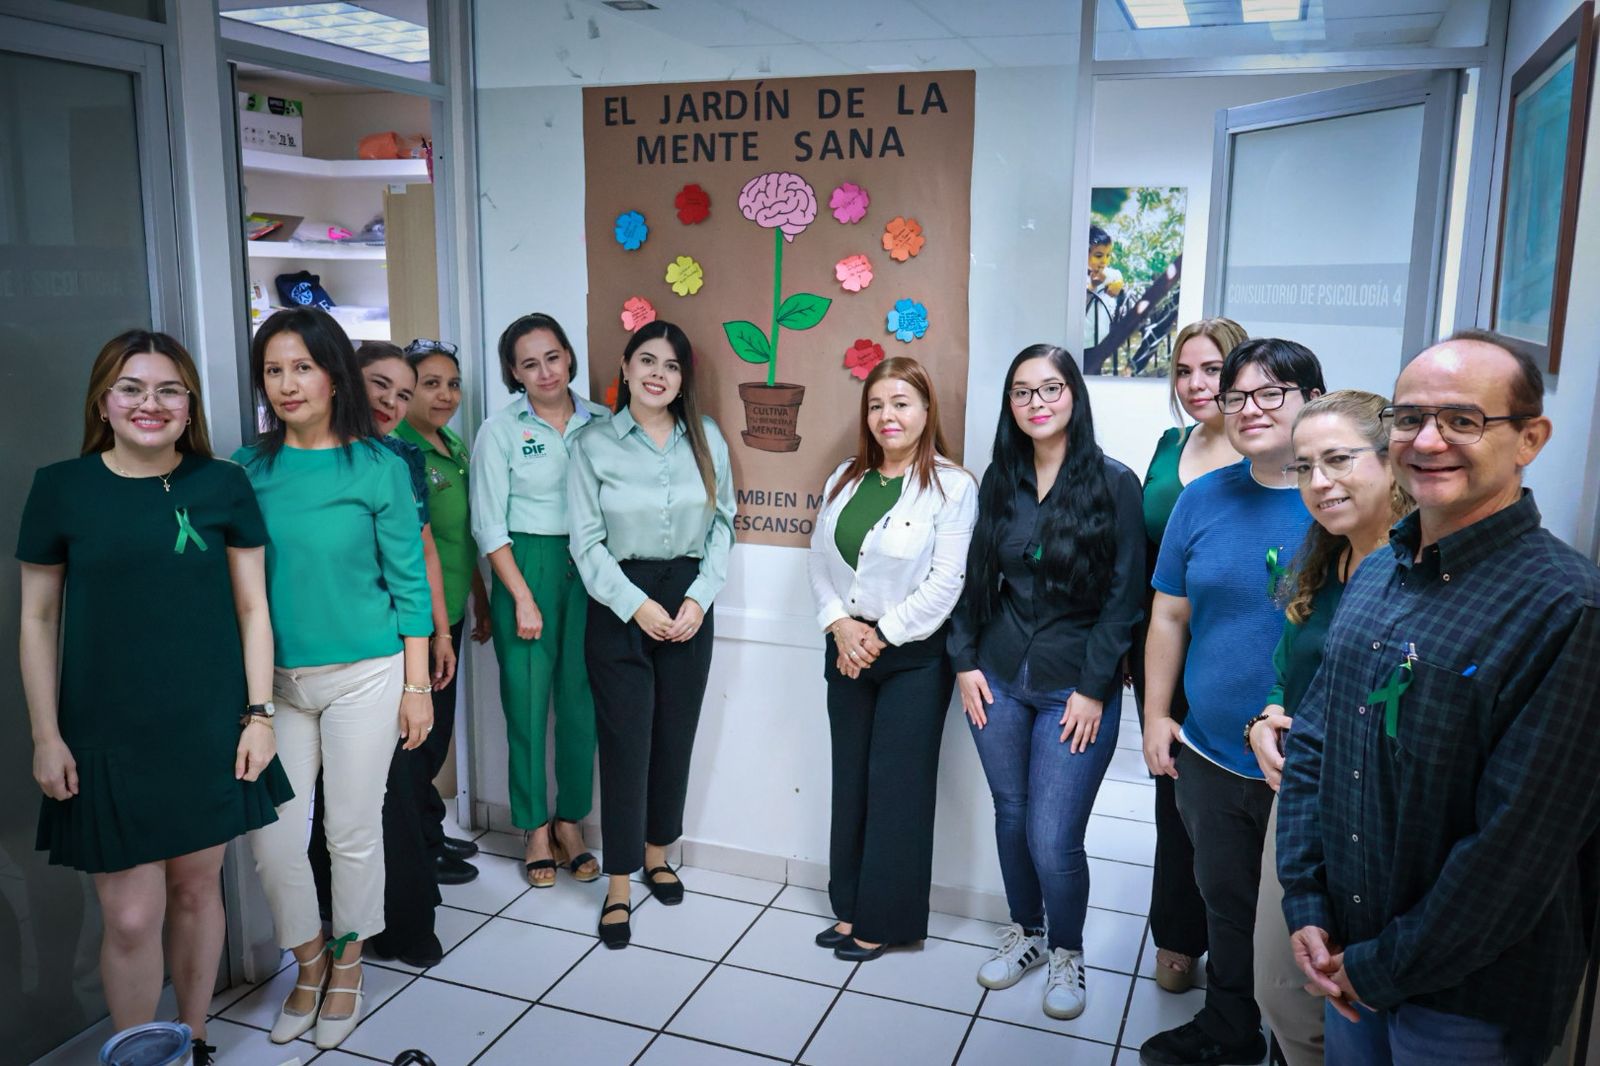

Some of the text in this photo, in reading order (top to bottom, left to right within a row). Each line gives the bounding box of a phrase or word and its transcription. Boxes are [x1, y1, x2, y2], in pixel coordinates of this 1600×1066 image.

[605, 81, 948, 126] EL JARDÍN DE LA
[637, 126, 905, 165] MENTE SANA
[1228, 279, 1402, 307] CONSULTORIO DE PSICOLOGÍA 4
[752, 406, 789, 417] CULTIVA
[751, 425, 787, 436] MENTAL
[522, 443, 545, 456] DIF
[737, 489, 797, 508] MBIEN
[733, 514, 813, 535] ESCANSO
